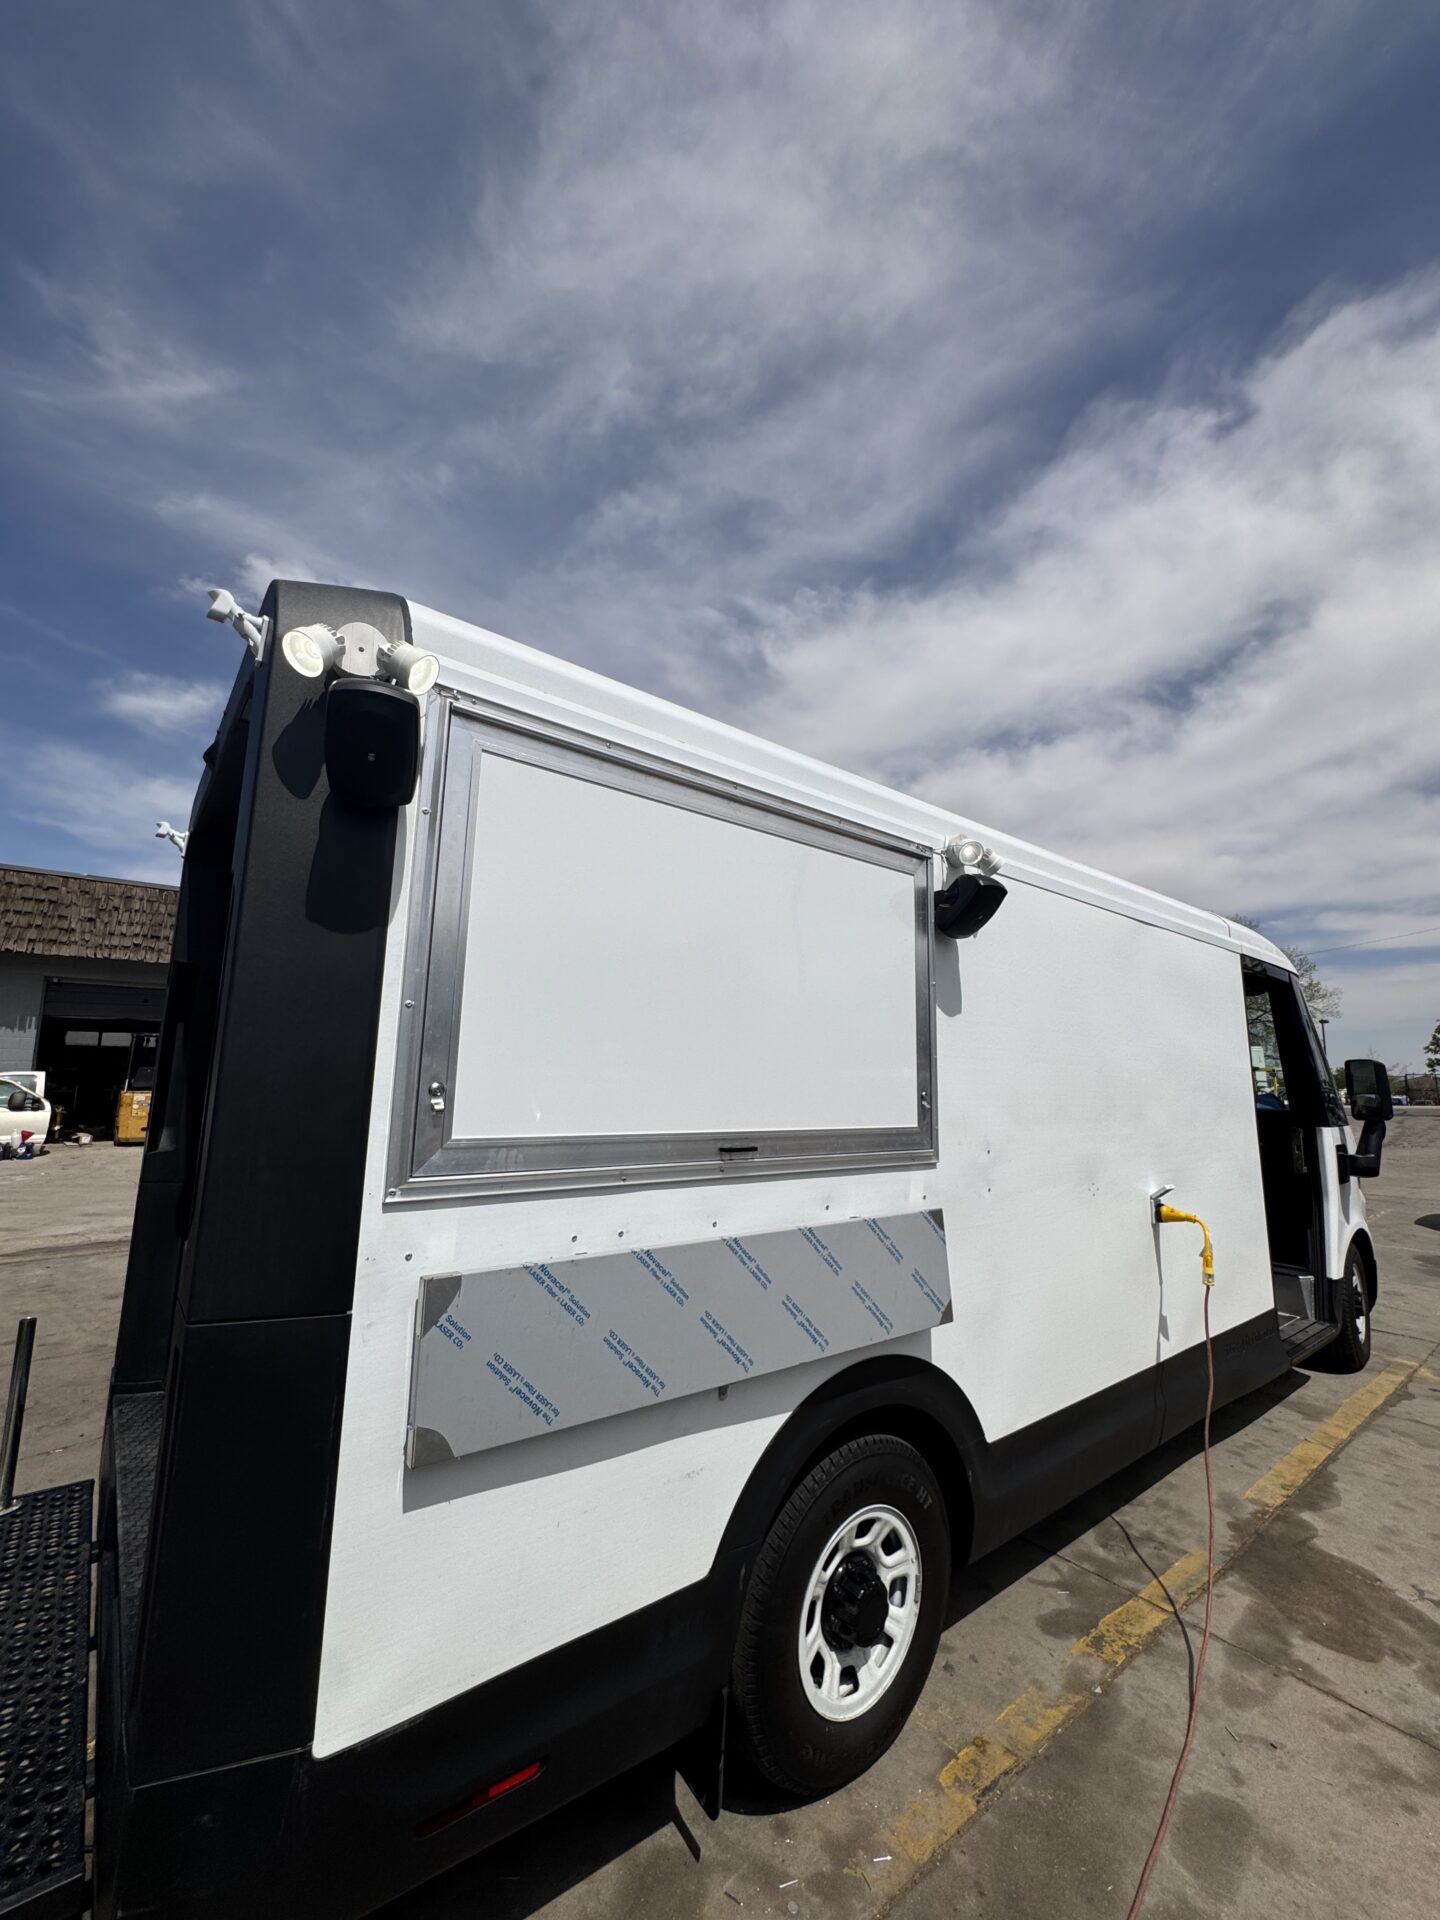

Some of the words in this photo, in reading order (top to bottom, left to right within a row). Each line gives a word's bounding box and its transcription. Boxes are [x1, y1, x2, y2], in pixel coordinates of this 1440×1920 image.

[528, 1267, 545, 1286] LASER
[544, 1284, 558, 1298] Fiber
[560, 1299, 576, 1317] LASER
[568, 1295, 590, 1319] Solution
[433, 1319, 454, 1340] LASER
[445, 1315, 471, 1341] Solution
[603, 1336, 624, 1360] Solution
[617, 1338, 632, 1355] LASER
[486, 1360, 511, 1386] Solution
[503, 1362, 521, 1380] LASER
[645, 1367, 660, 1383] LASER
[523, 1381, 537, 1395] Fiber
[536, 1392, 553, 1410] LASER
[542, 1412, 553, 1426] The
[915, 1485, 934, 1511] HT
